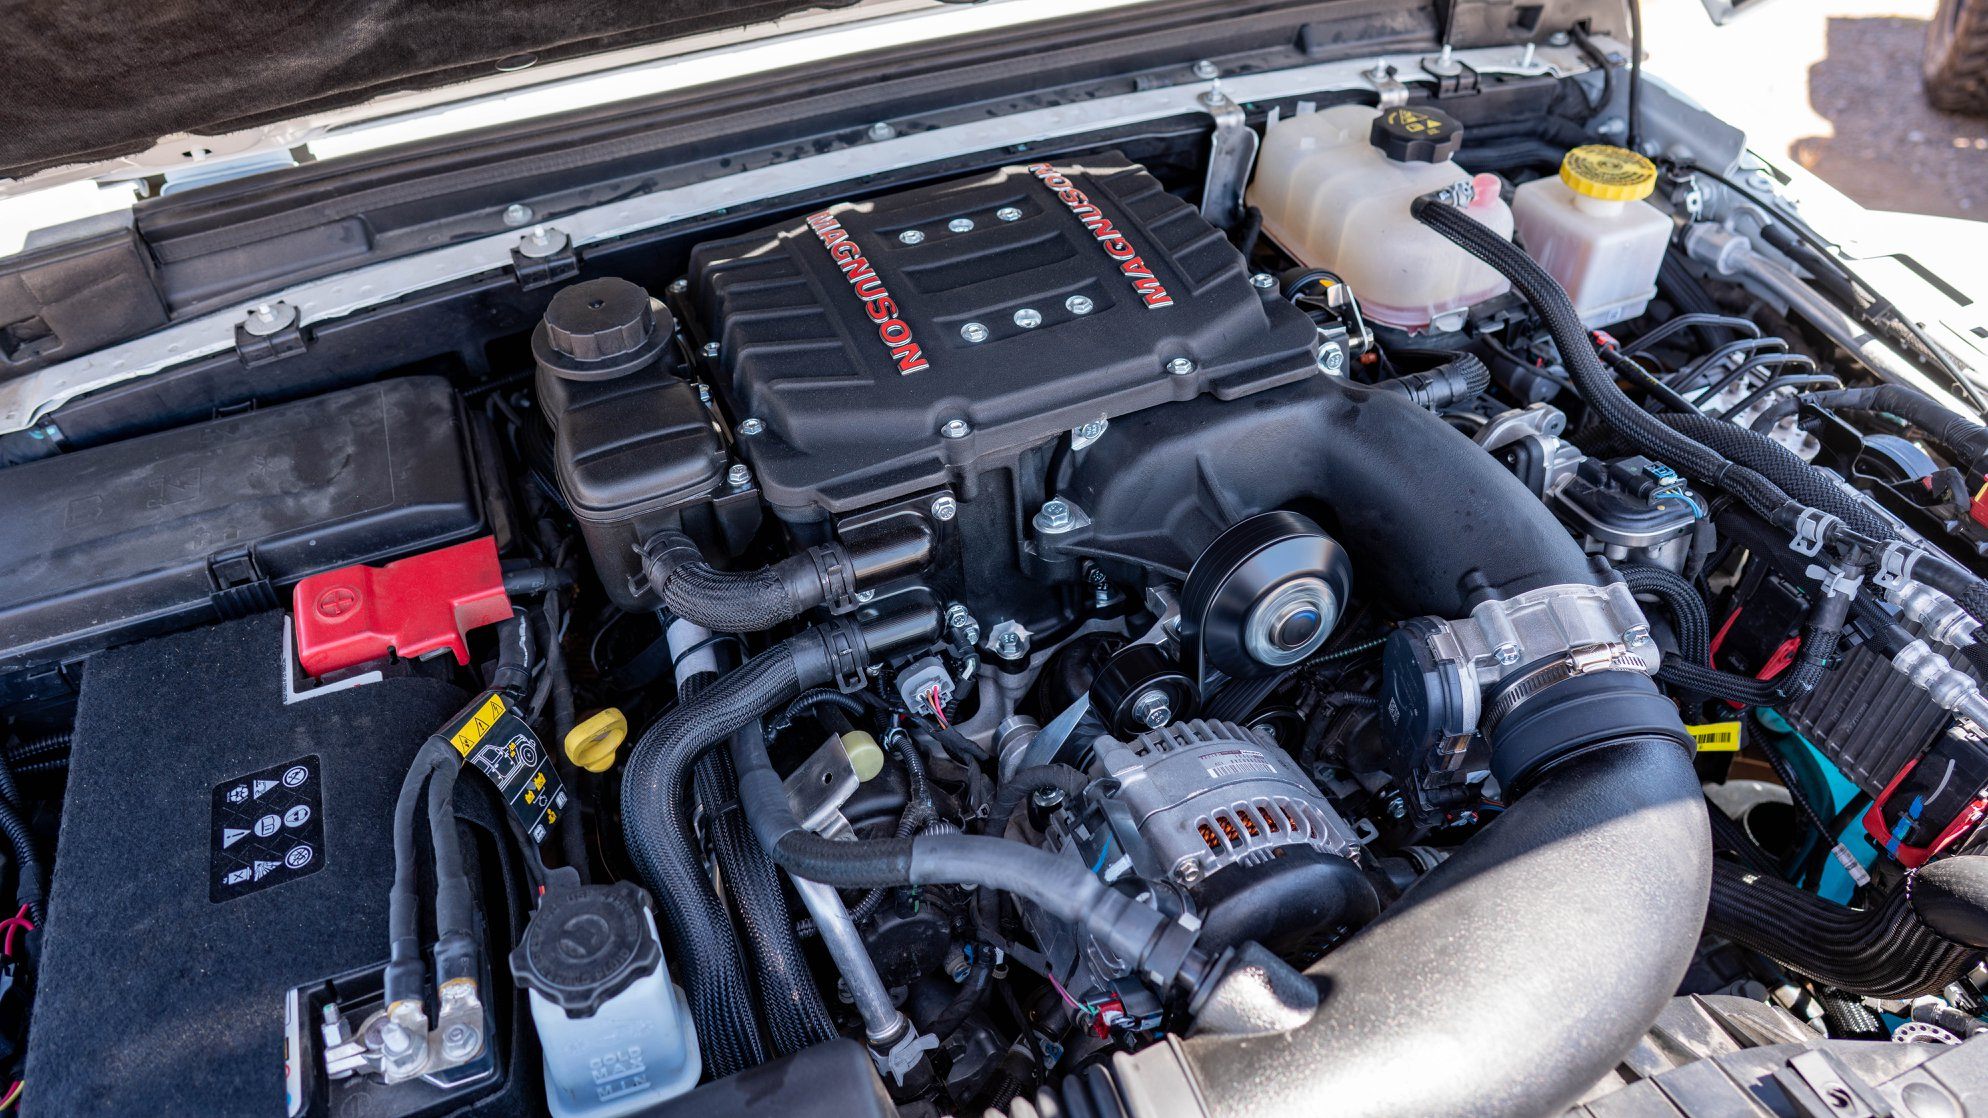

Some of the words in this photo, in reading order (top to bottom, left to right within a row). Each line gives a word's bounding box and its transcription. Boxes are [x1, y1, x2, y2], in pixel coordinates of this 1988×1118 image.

[1028, 163, 1173, 308] MAGNUSON
[806, 210, 929, 375] MAGNUSON
[590, 1045, 641, 1069] COLD
[592, 1056, 645, 1082] MAX
[597, 1074, 647, 1098] MIN
